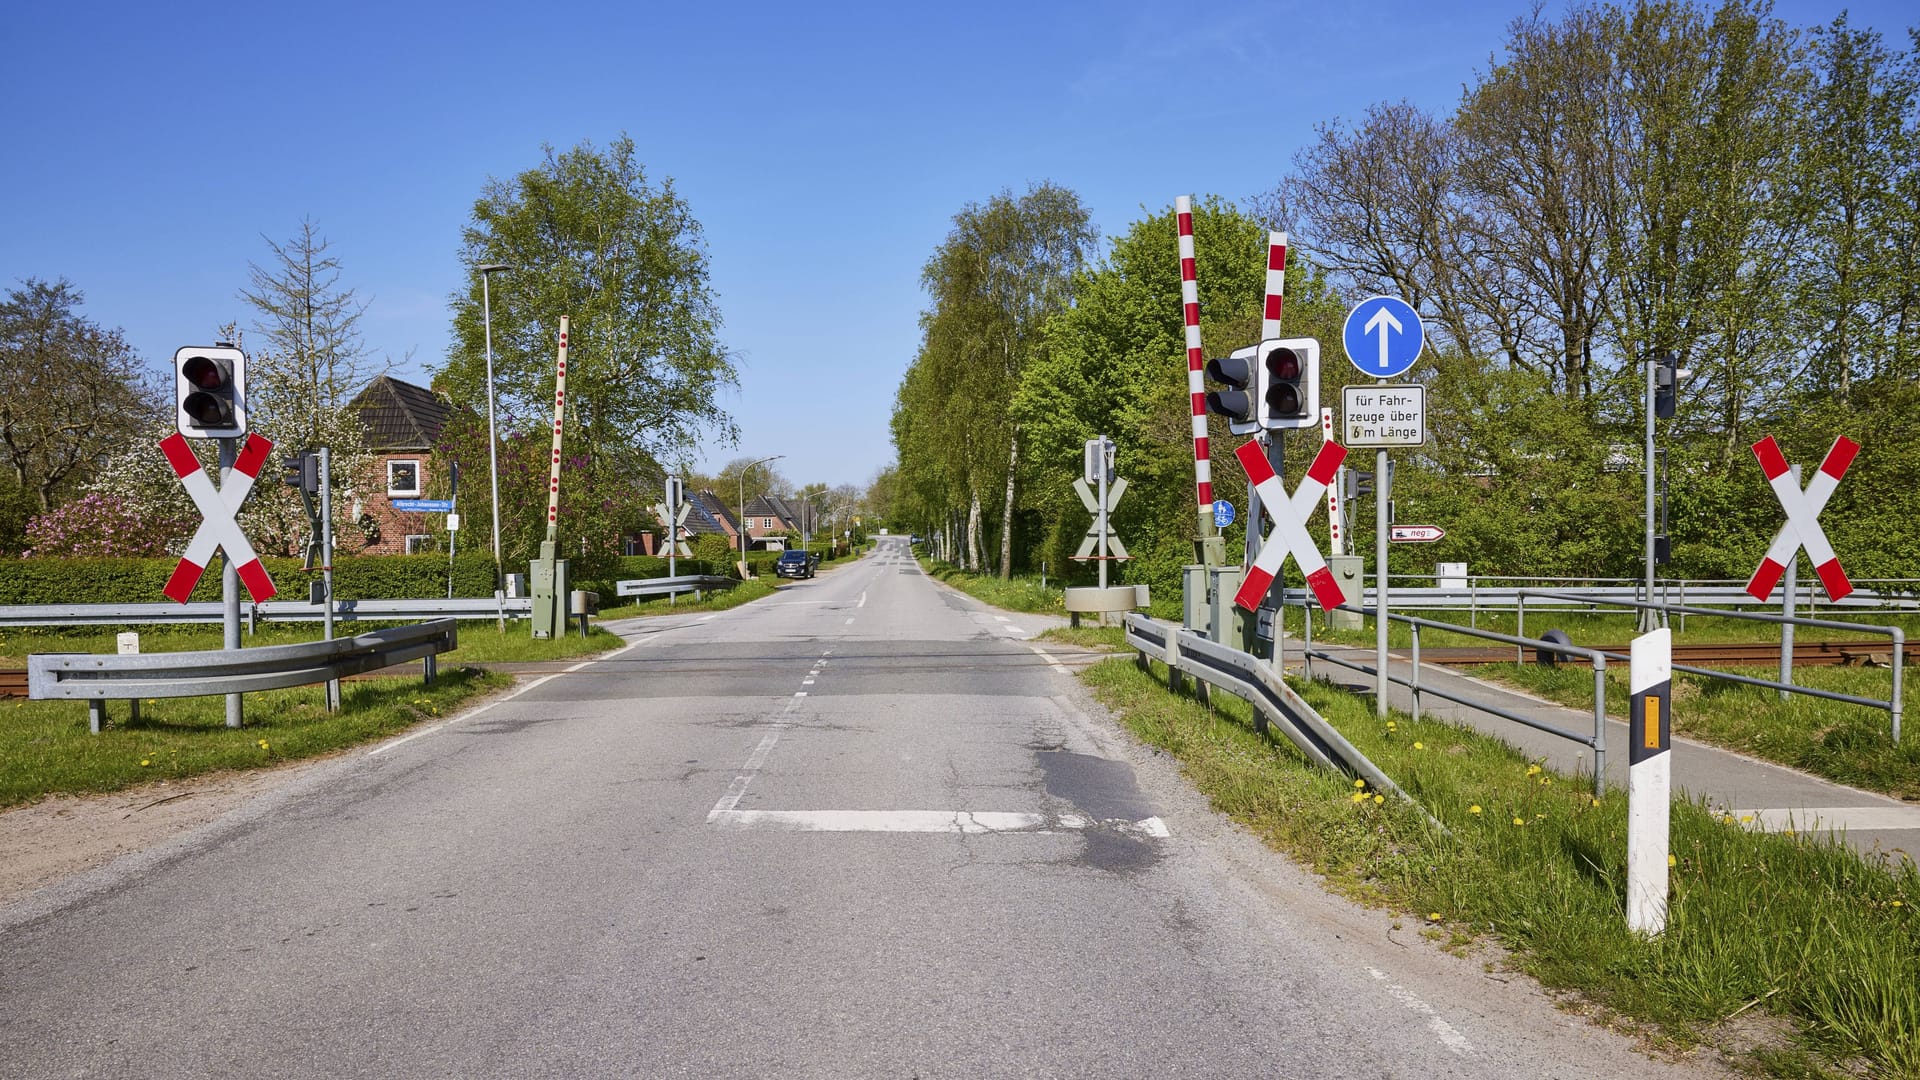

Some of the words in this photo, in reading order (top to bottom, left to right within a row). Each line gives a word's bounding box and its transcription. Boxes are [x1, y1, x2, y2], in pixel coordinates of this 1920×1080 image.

[1356, 396, 1373, 406] für
[1380, 395, 1412, 406] Fahr-
[1349, 413, 1384, 424] zeuge
[1391, 411, 1418, 421] über
[1354, 426, 1359, 438] 6
[1364, 429, 1375, 437] m
[1381, 426, 1416, 439] Länge
